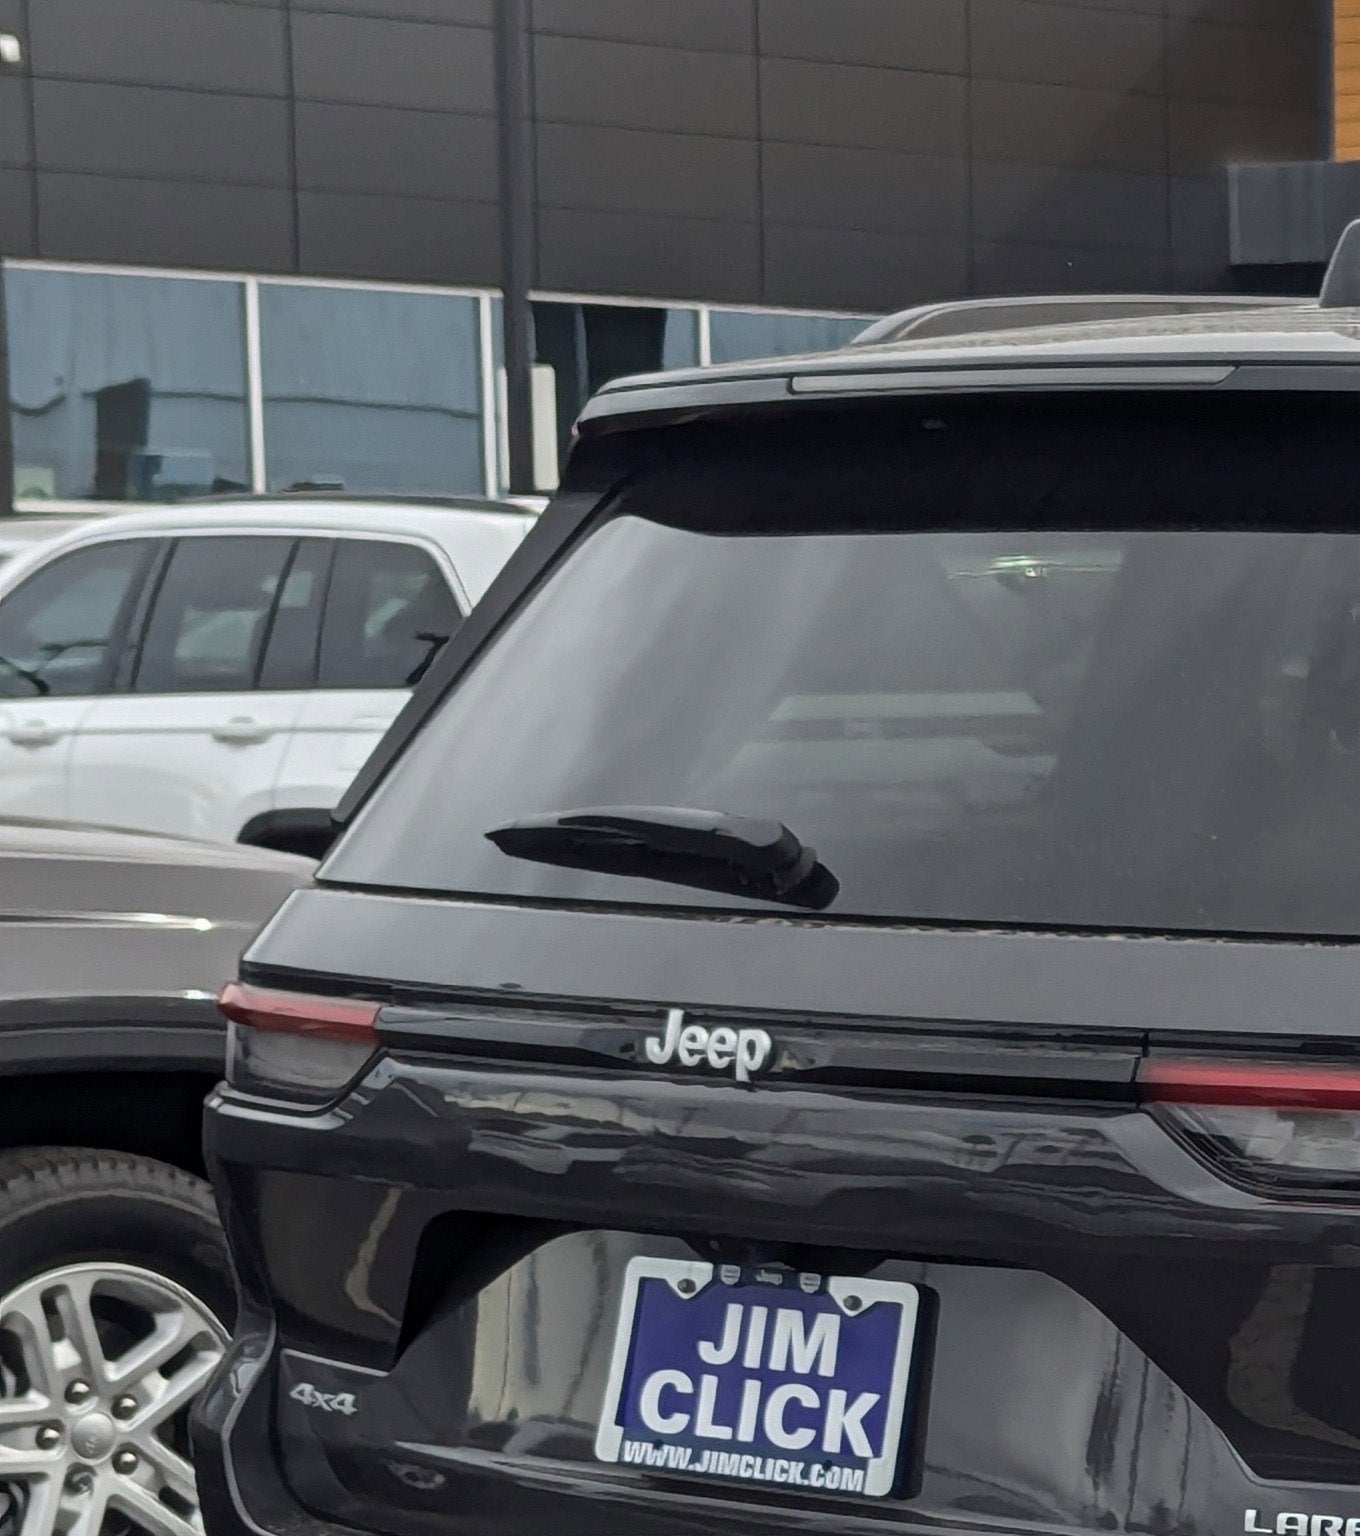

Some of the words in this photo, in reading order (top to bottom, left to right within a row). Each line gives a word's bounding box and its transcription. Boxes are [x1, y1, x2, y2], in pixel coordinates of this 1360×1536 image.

[646, 1008, 772, 1082] Jeep
[697, 1303, 841, 1377] JIM
[290, 1382, 358, 1415] 4x4
[640, 1369, 881, 1458] CLICK
